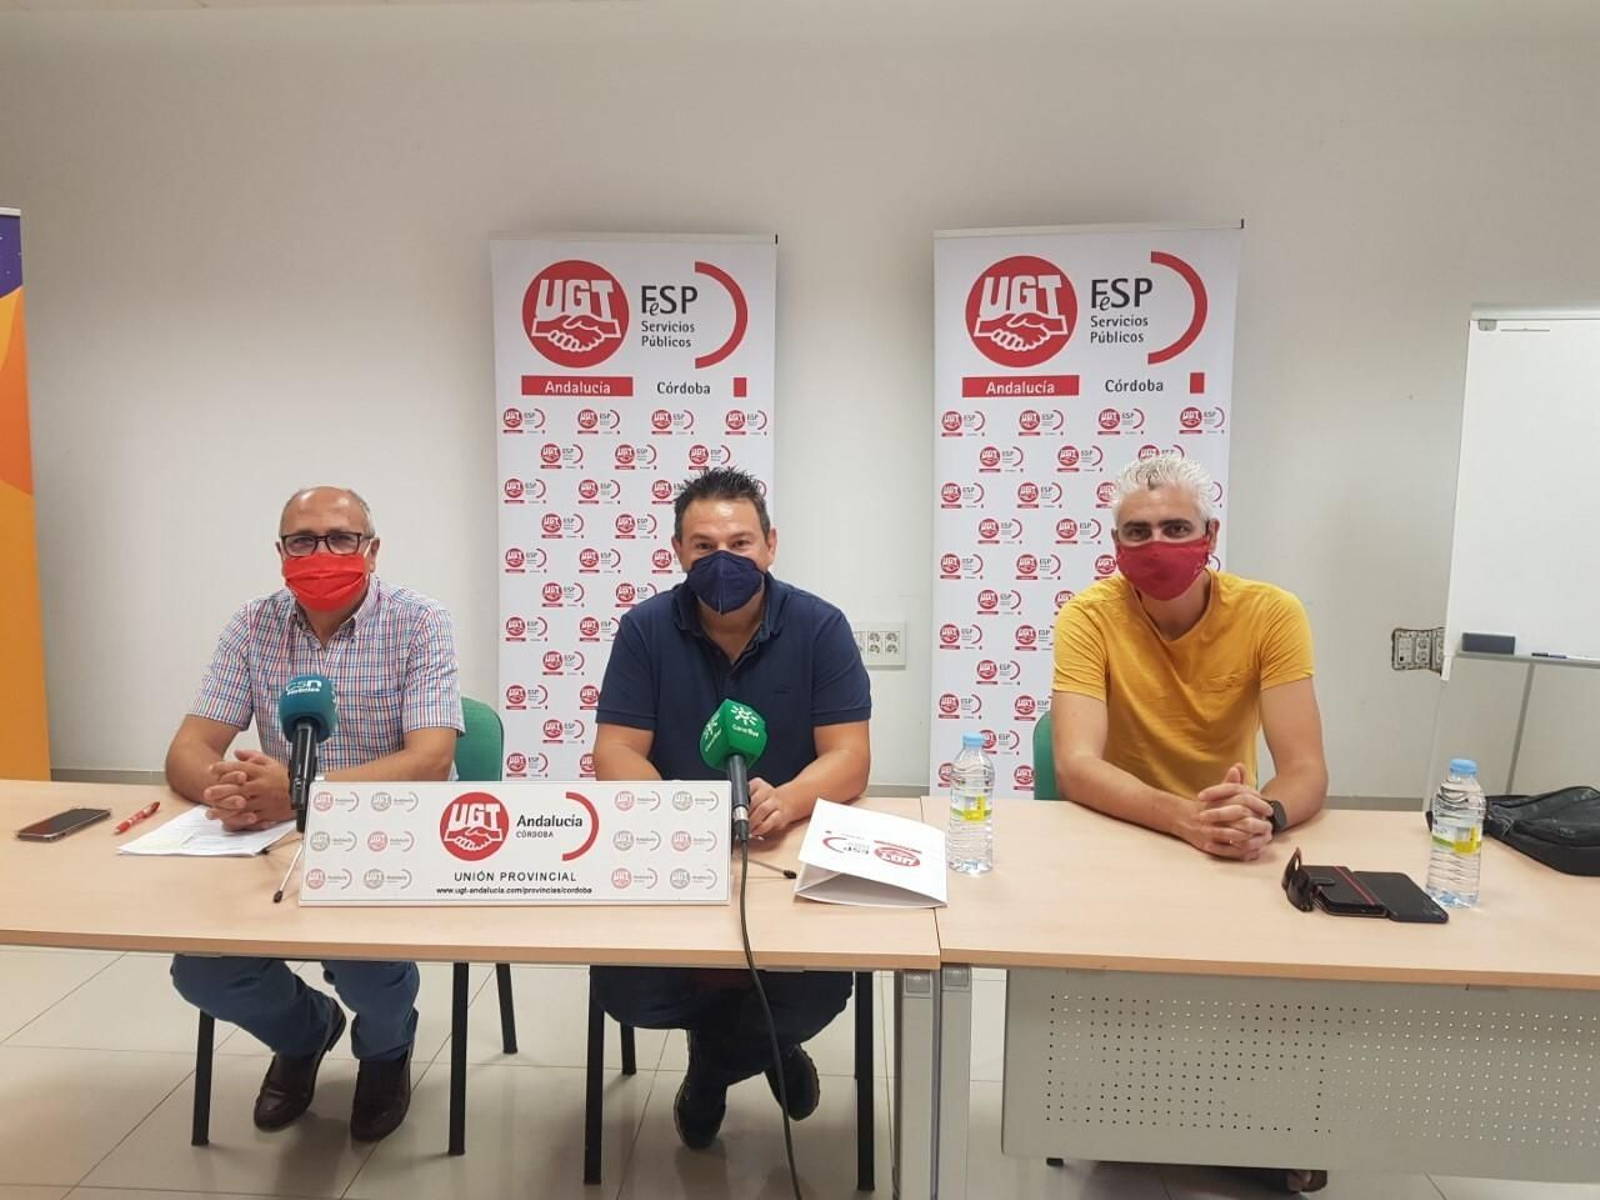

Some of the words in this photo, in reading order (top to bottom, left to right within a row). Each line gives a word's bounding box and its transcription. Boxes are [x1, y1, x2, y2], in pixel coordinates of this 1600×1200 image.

[535, 279, 614, 320] UGT
[979, 274, 1062, 319] UGT
[641, 320, 695, 333] Servicios
[1090, 315, 1149, 328] Servicios
[641, 335, 691, 348] Públicos
[1090, 330, 1144, 344] Públicos
[544, 381, 611, 394] Andalucía
[657, 381, 711, 394] Córdoba
[985, 380, 1055, 395] Andalucía
[1104, 378, 1164, 393] Córdoba
[448, 803, 500, 831] UGT
[516, 814, 583, 828] Andalucía
[516, 830, 554, 838] CÓRDOBA
[454, 870, 495, 882] UNIÓN
[500, 872, 577, 882] PROVINCIAL
